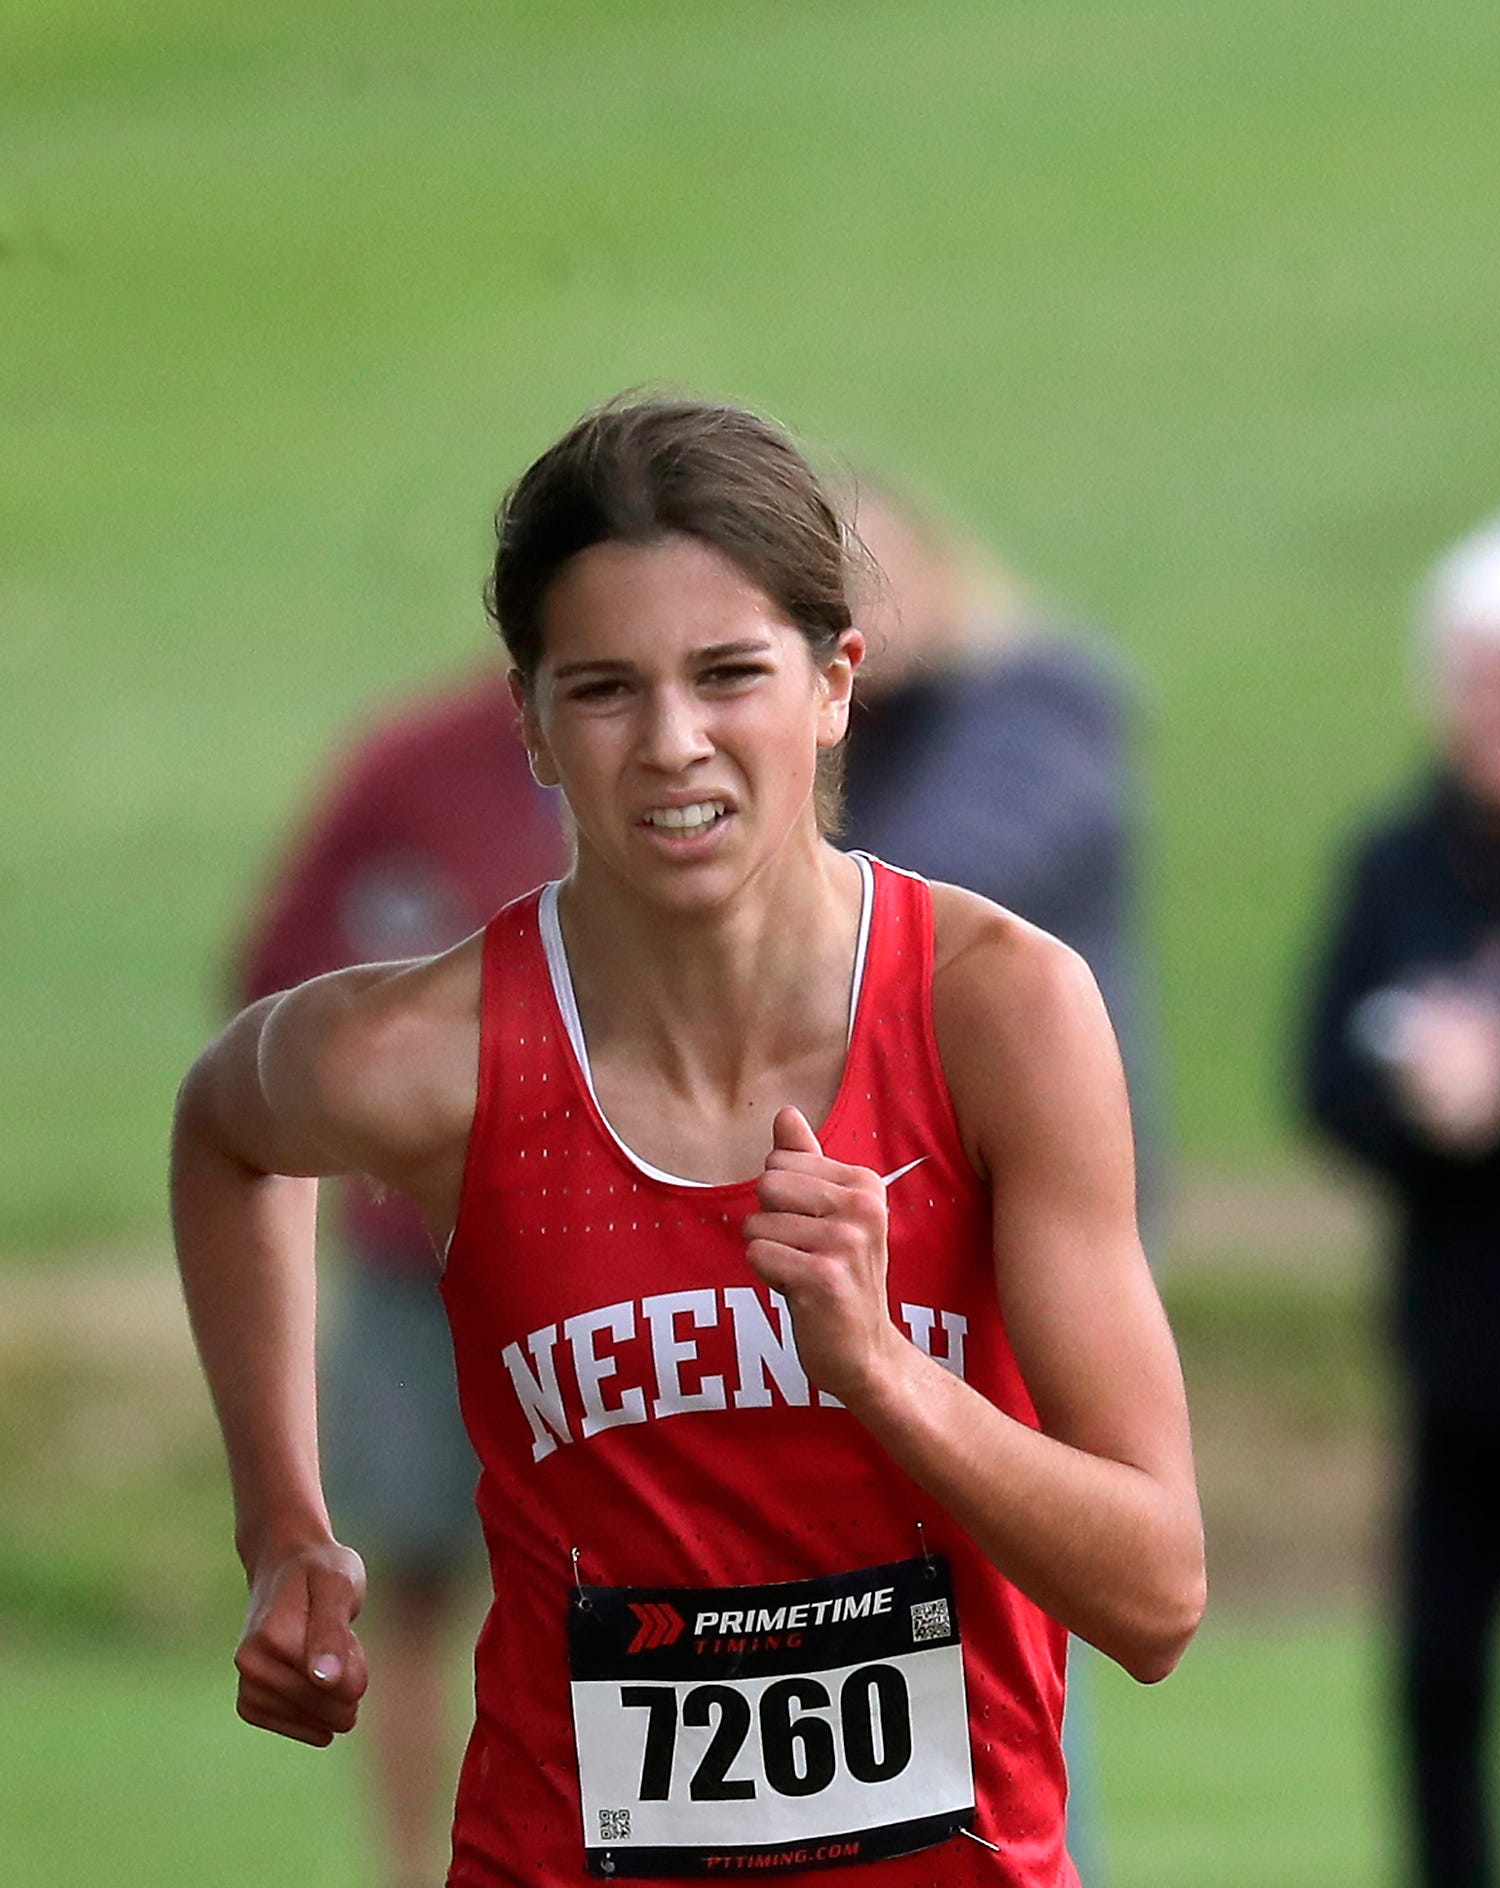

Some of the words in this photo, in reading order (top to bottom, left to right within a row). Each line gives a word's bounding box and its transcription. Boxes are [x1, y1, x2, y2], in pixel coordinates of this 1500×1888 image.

[501, 1287, 968, 1462] NEENH
[694, 1587, 895, 1636] PRIMETIME
[694, 1634, 802, 1655] TIMING
[620, 1663, 913, 1802] 7260
[706, 1842, 861, 1868] PTTIMING.COM
